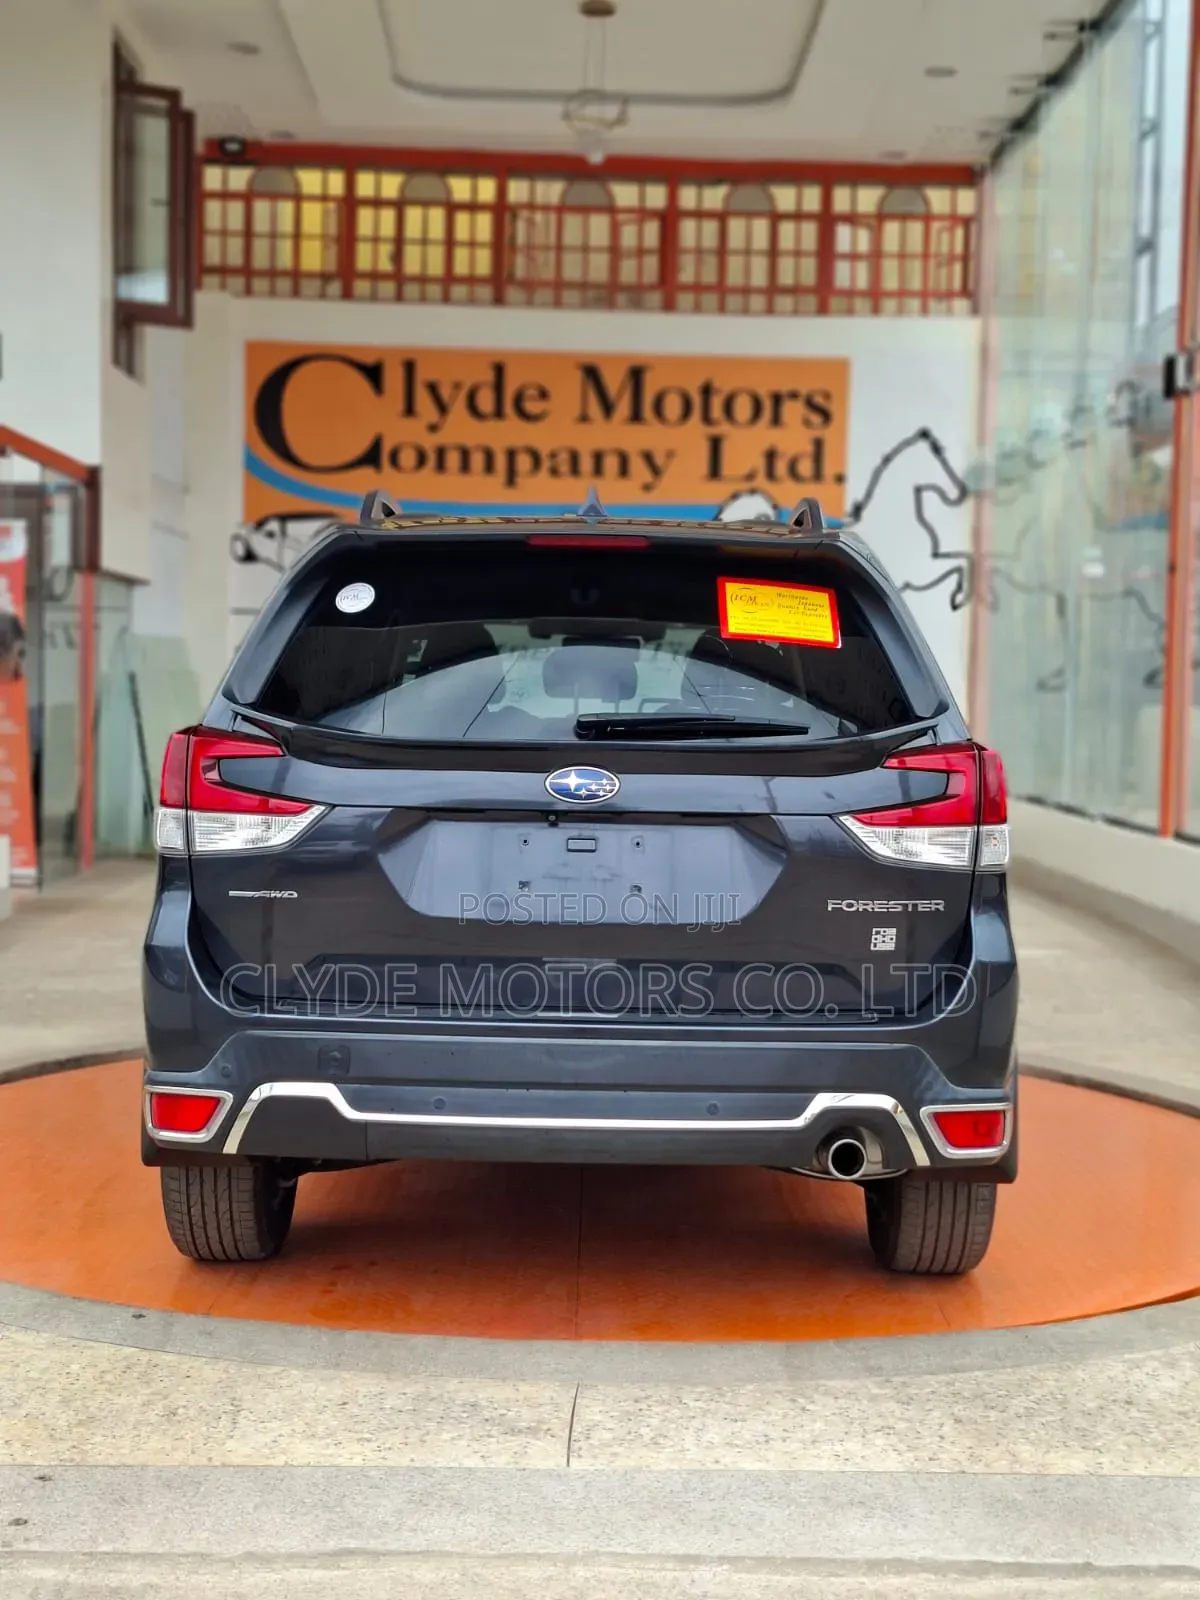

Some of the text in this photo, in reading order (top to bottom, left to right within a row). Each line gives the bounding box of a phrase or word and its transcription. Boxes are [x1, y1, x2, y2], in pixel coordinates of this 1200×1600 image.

[253, 353, 833, 474] Clyde Motors
[704, 433, 846, 484] Ltd.
[827, 899, 945, 912] FORESTER
